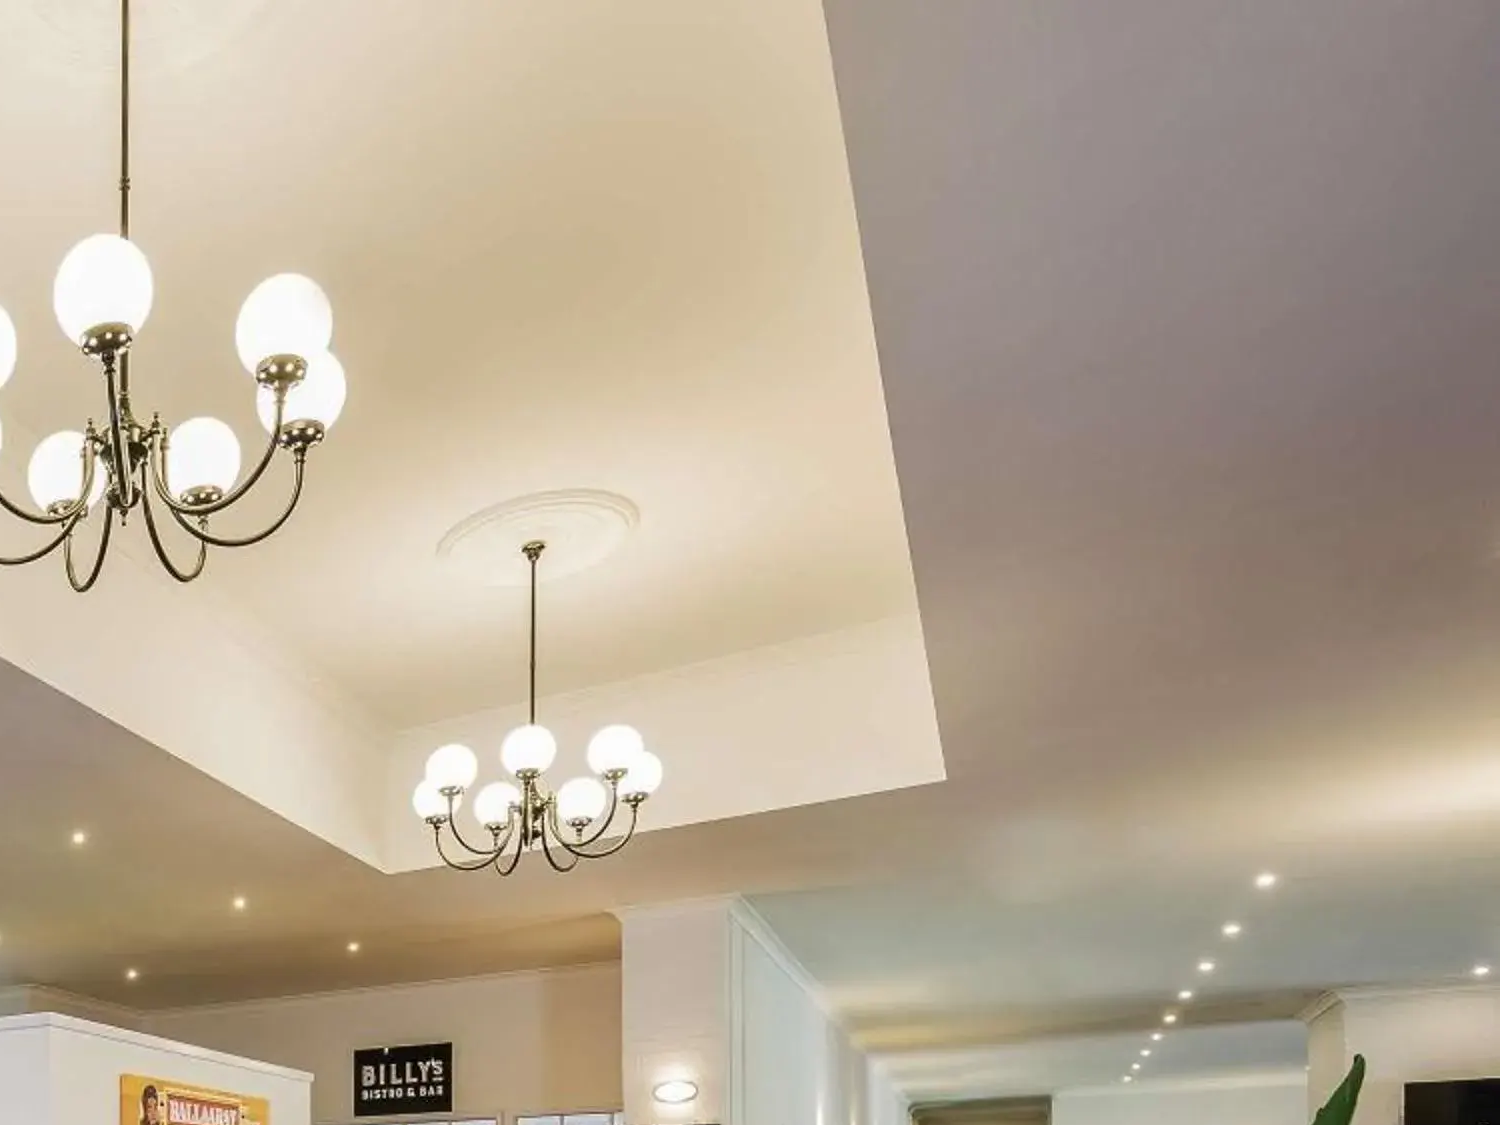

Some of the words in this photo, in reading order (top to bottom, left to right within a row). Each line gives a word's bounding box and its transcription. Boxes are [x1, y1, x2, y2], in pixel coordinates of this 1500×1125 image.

[362, 1057, 445, 1087] BILLY'S
[361, 1087, 403, 1100] BISTRO
[419, 1085, 444, 1097] BAR
